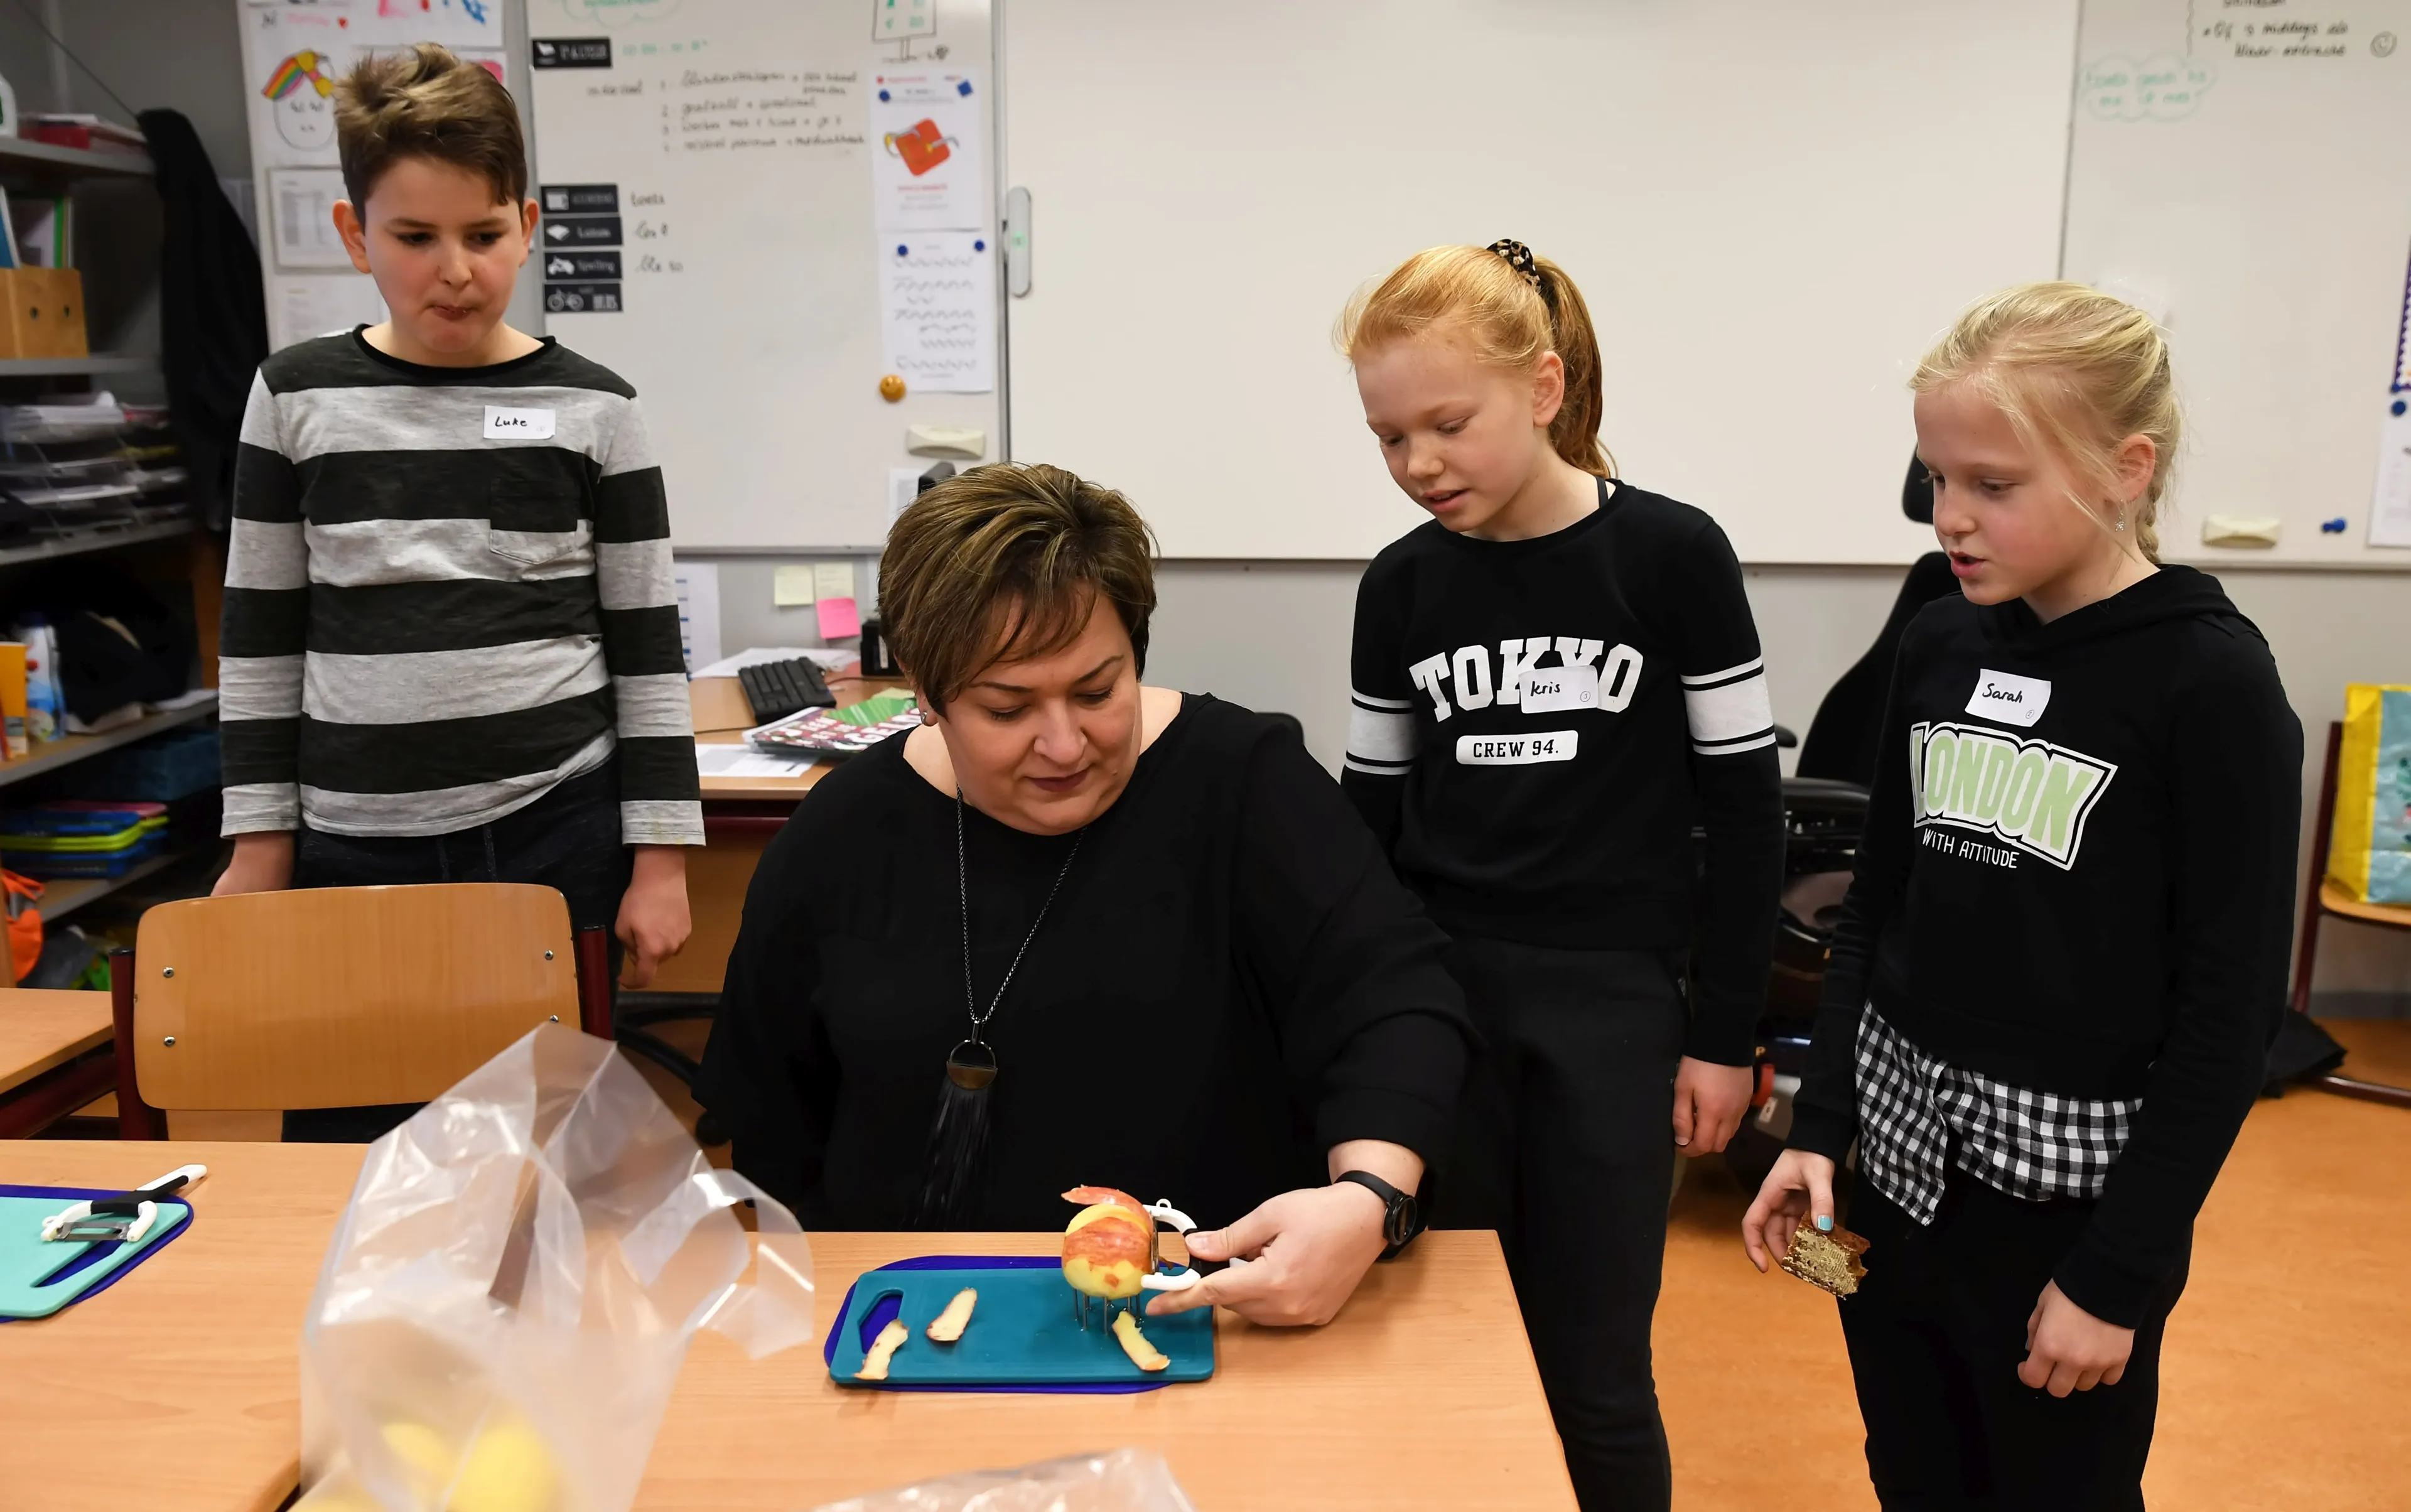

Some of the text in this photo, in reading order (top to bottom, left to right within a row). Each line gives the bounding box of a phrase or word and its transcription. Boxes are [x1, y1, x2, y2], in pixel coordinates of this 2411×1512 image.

[495, 416, 528, 427] Luke
[1409, 636, 1643, 722] TOKYO
[1982, 683, 2023, 703] Sarah
[1473, 739, 1558, 758] CREW 94.
[1911, 728, 2105, 862] LONDON
